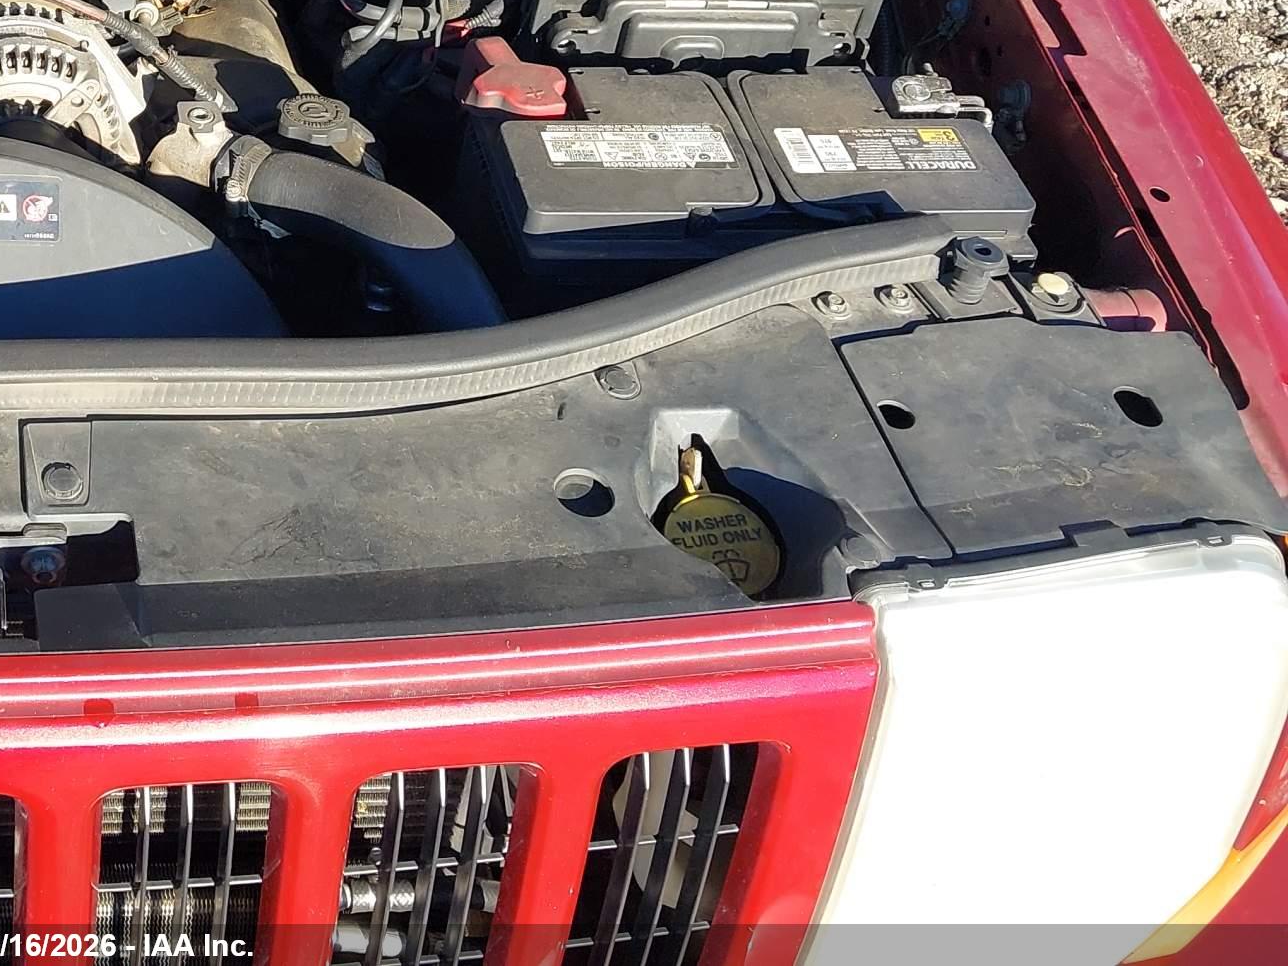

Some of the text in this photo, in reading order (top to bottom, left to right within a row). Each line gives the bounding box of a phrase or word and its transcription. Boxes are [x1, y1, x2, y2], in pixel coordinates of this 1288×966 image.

[905, 160, 977, 170] DURACELL
[676, 514, 747, 533] WASHER
[671, 528, 761, 549] FLUID ONLY
